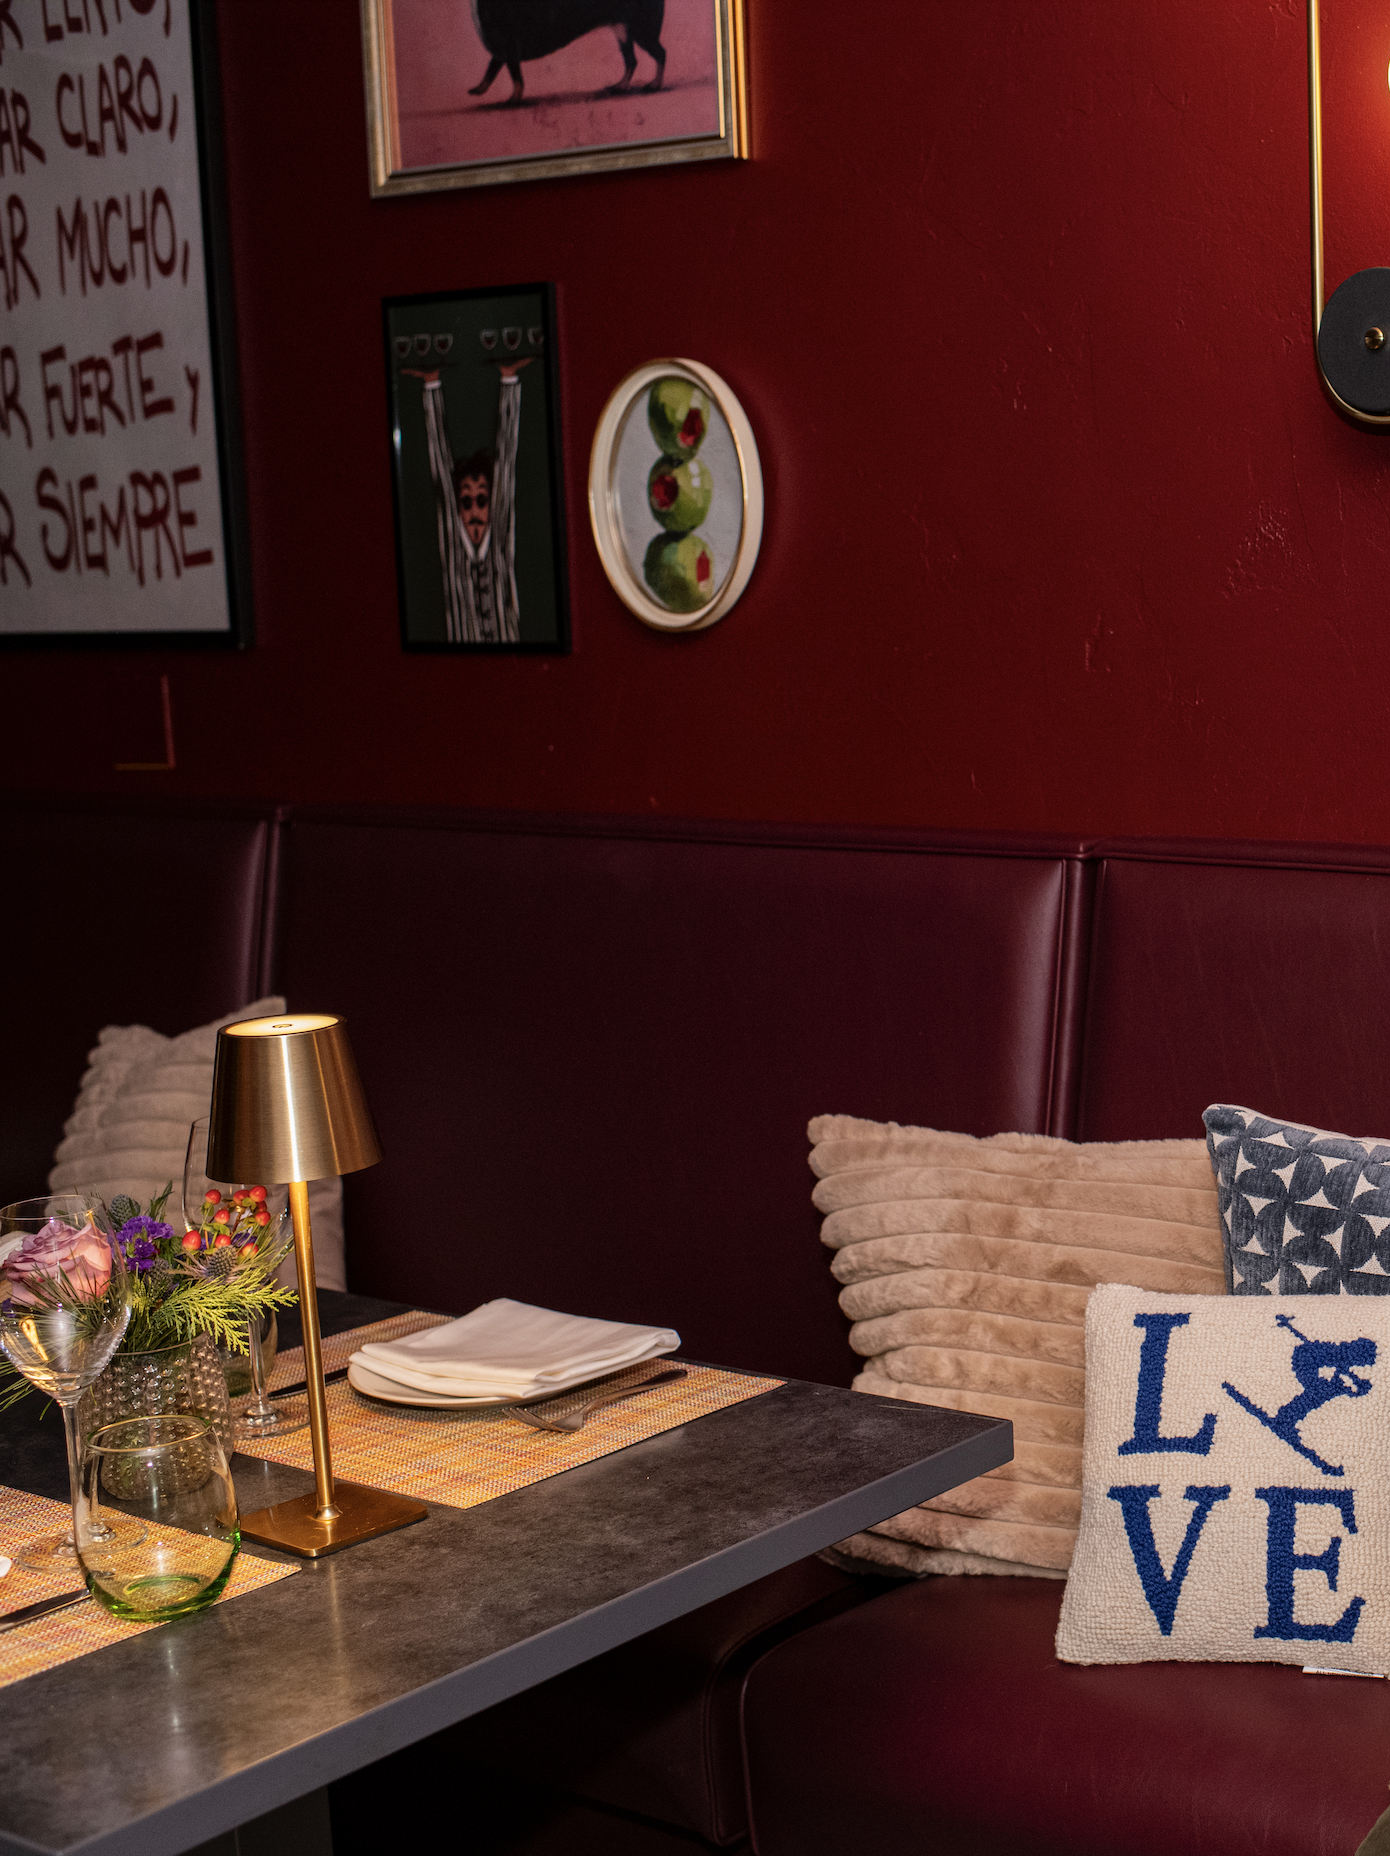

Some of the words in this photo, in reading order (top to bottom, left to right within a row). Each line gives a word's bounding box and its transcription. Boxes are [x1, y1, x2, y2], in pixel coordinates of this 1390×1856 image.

[56, 54, 178, 158] CLARO,
[56, 186, 190, 297] MUCHO,
[41, 331, 175, 440] FUERTE
[35, 466, 214, 588] SIEMPRE
